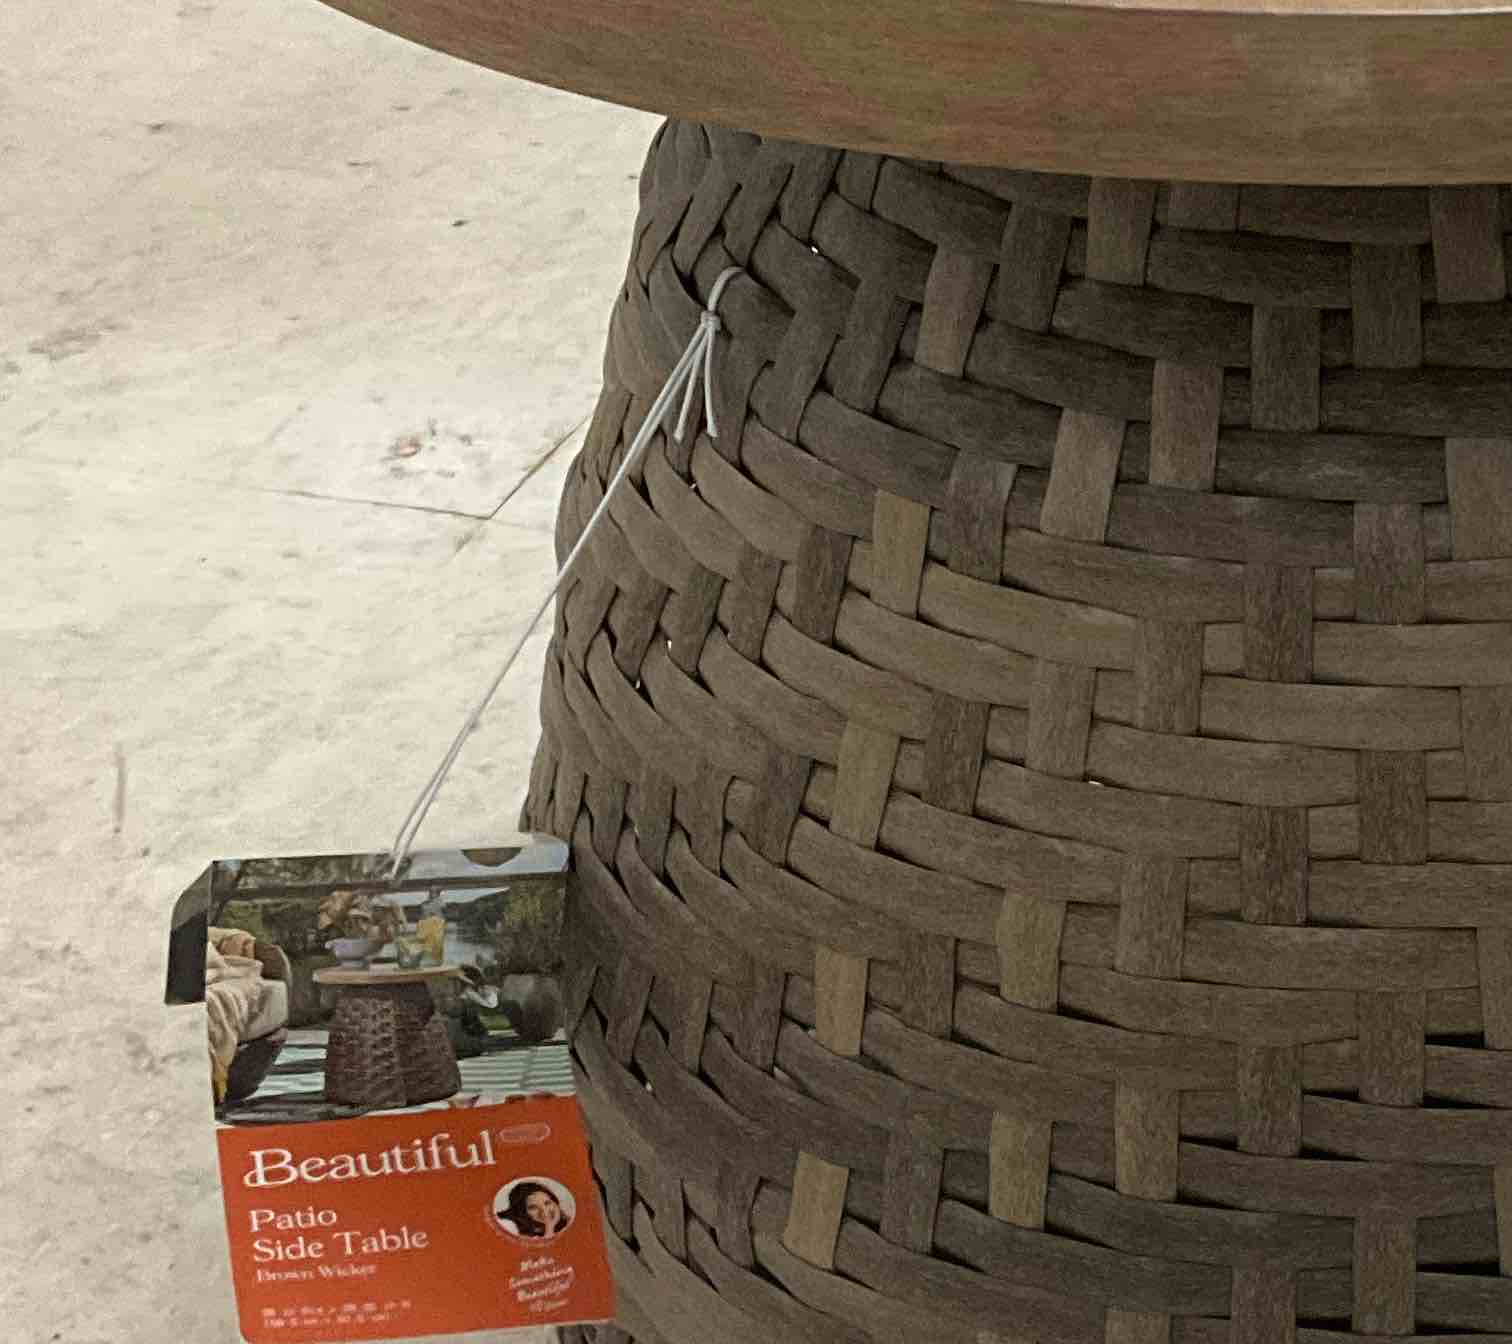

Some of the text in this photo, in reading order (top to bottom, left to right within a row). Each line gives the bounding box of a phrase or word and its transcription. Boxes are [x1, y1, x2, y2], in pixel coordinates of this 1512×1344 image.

[242, 1129, 498, 1189] Beautiful
[249, 1206, 337, 1233] Patio
[253, 1226, 430, 1263] Side Table
